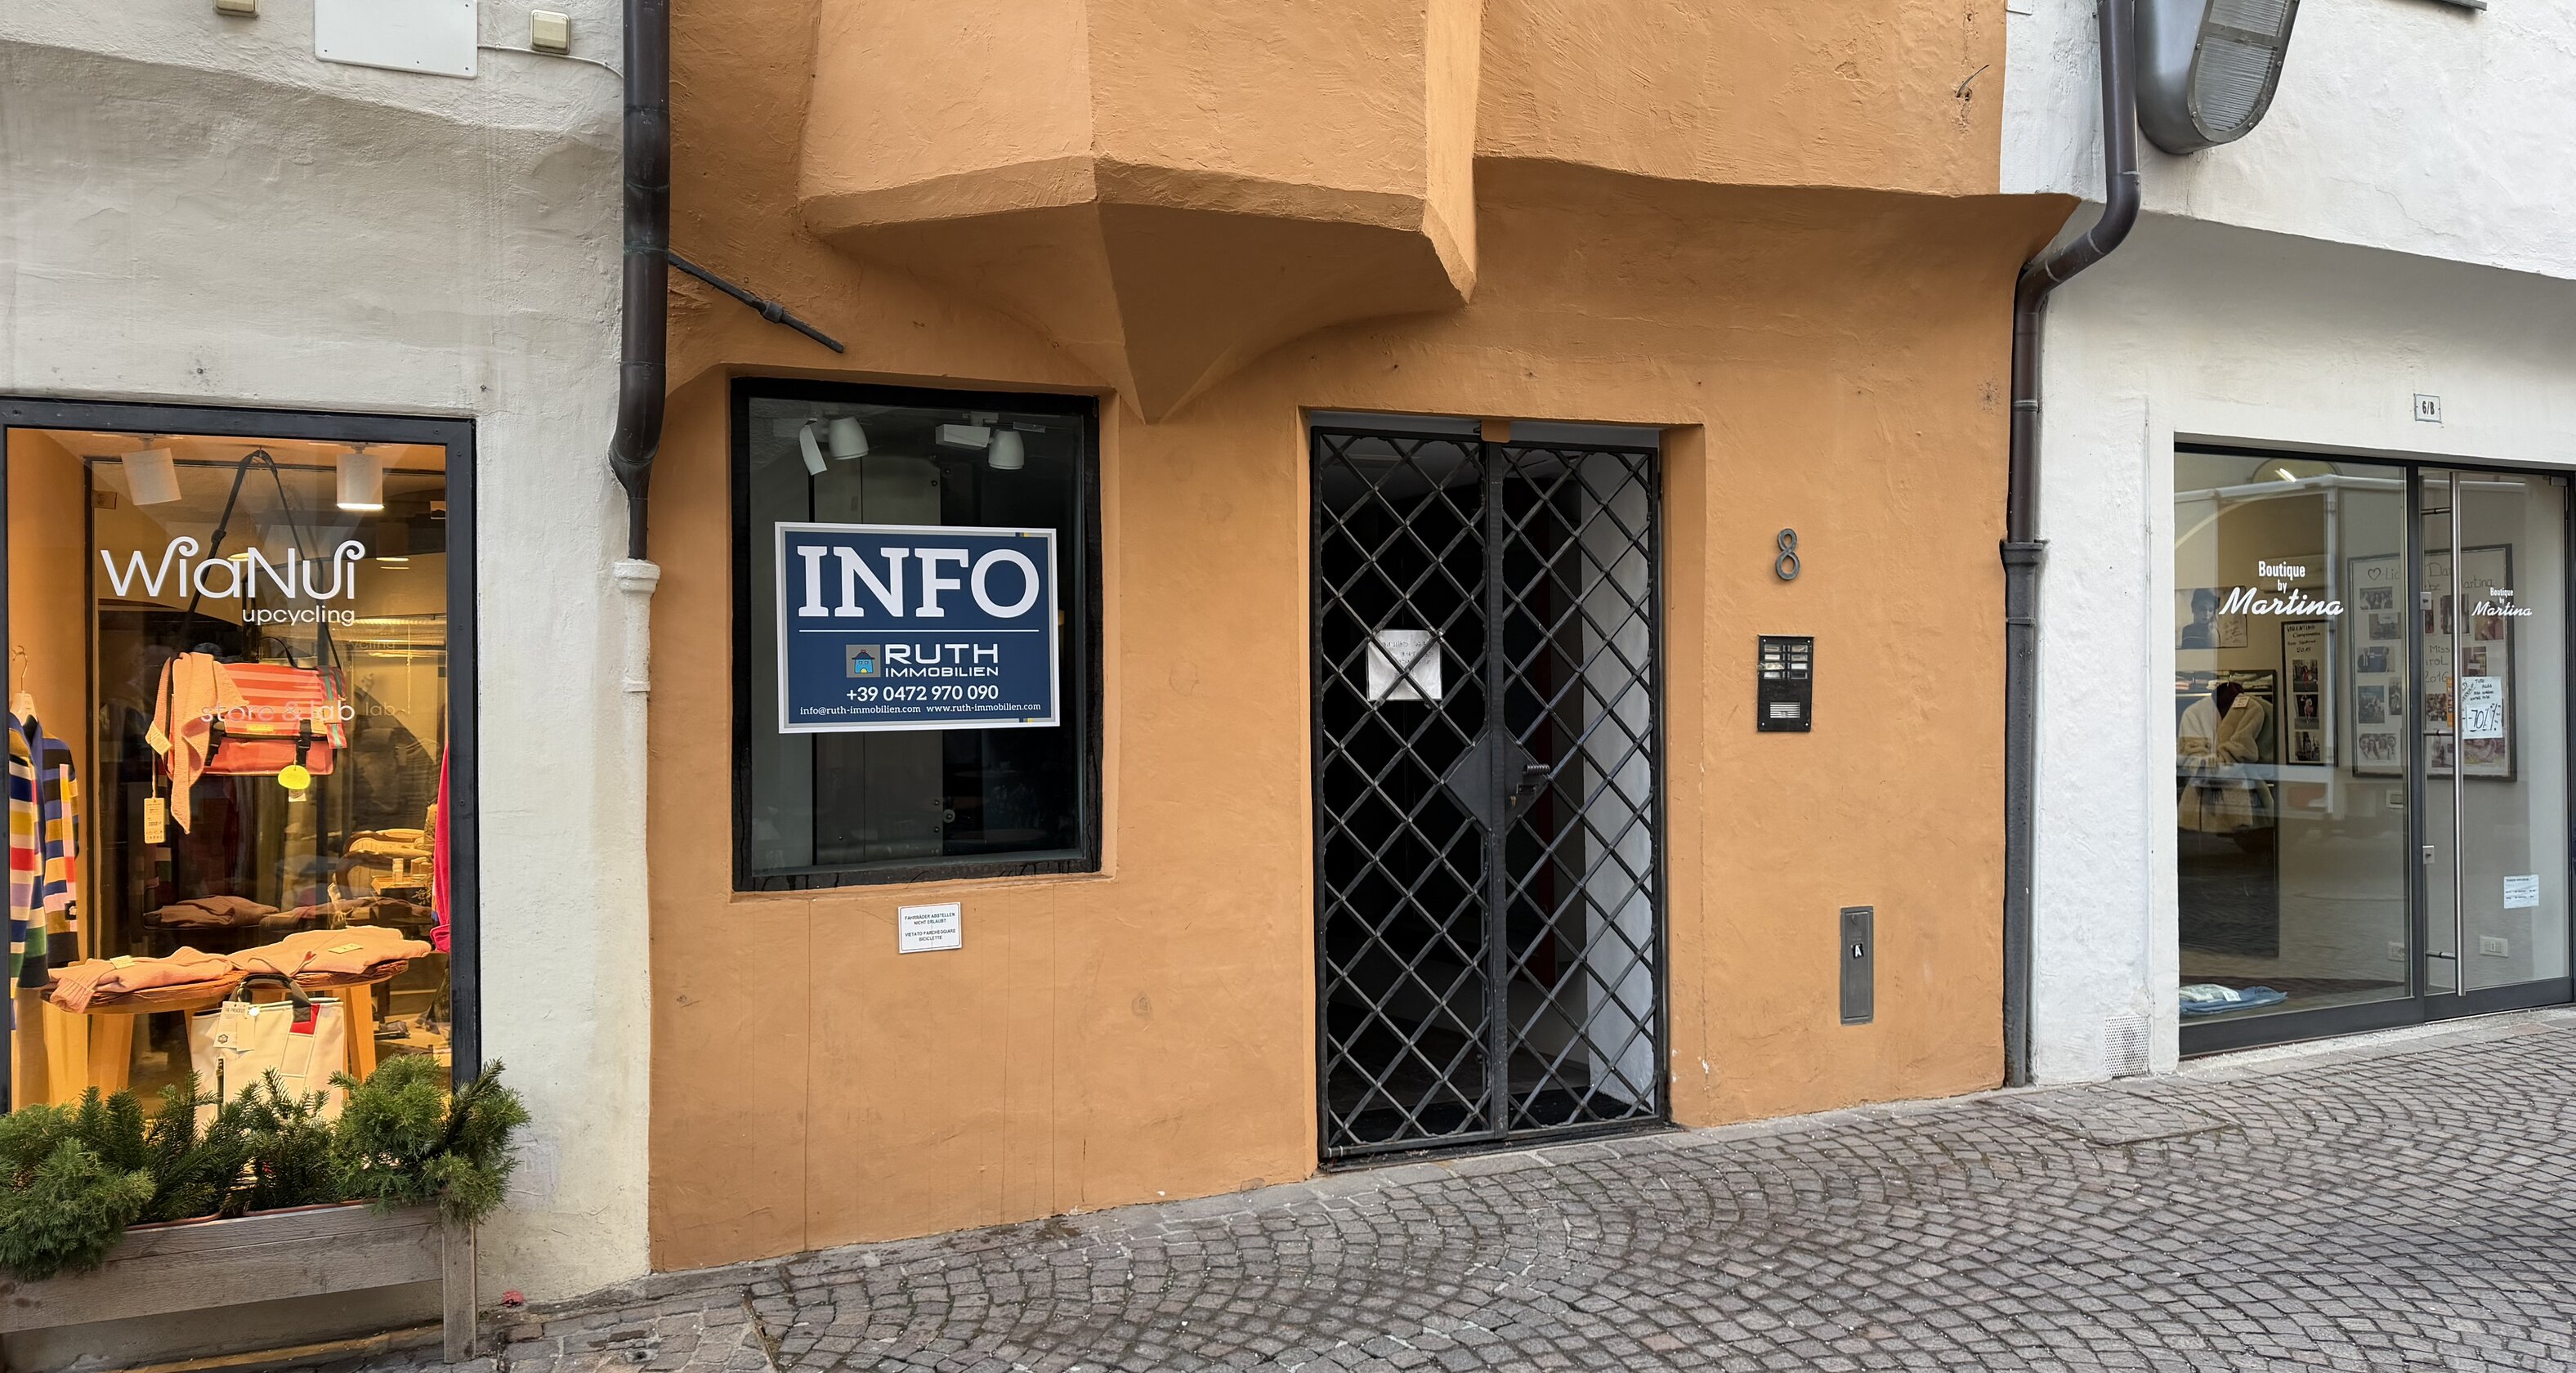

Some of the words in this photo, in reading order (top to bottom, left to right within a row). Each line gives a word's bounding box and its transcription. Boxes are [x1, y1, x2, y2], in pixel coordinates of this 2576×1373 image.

[2422, 400, 2435, 415] 6/B
[1775, 528, 1800, 581] 8
[2258, 560, 2306, 581] Boutique
[796, 545, 1040, 619] INFO
[2277, 579, 2288, 594] by
[2461, 575, 2494, 589] artina
[2489, 587, 2514, 598] Boutique
[2218, 586, 2344, 615] Martina
[2498, 597, 2505, 606] by
[242, 605, 356, 626] upcycling
[2471, 601, 2533, 616] Martina
[885, 643, 999, 664] RUTH
[885, 666, 999, 678] IMMOBILIEN
[846, 686, 879, 702] +39
[883, 686, 928, 701] 0472
[931, 685, 964, 700] 970
[967, 684, 999, 700] 090
[200, 700, 275, 723] store
[281, 700, 303, 722] &
[311, 699, 356, 722] lab
[799, 704, 921, 716] info@ruth-immobilien.com
[925, 701, 1041, 713] www.ruth-immobilien.com
[1854, 944, 1863, 958] A
